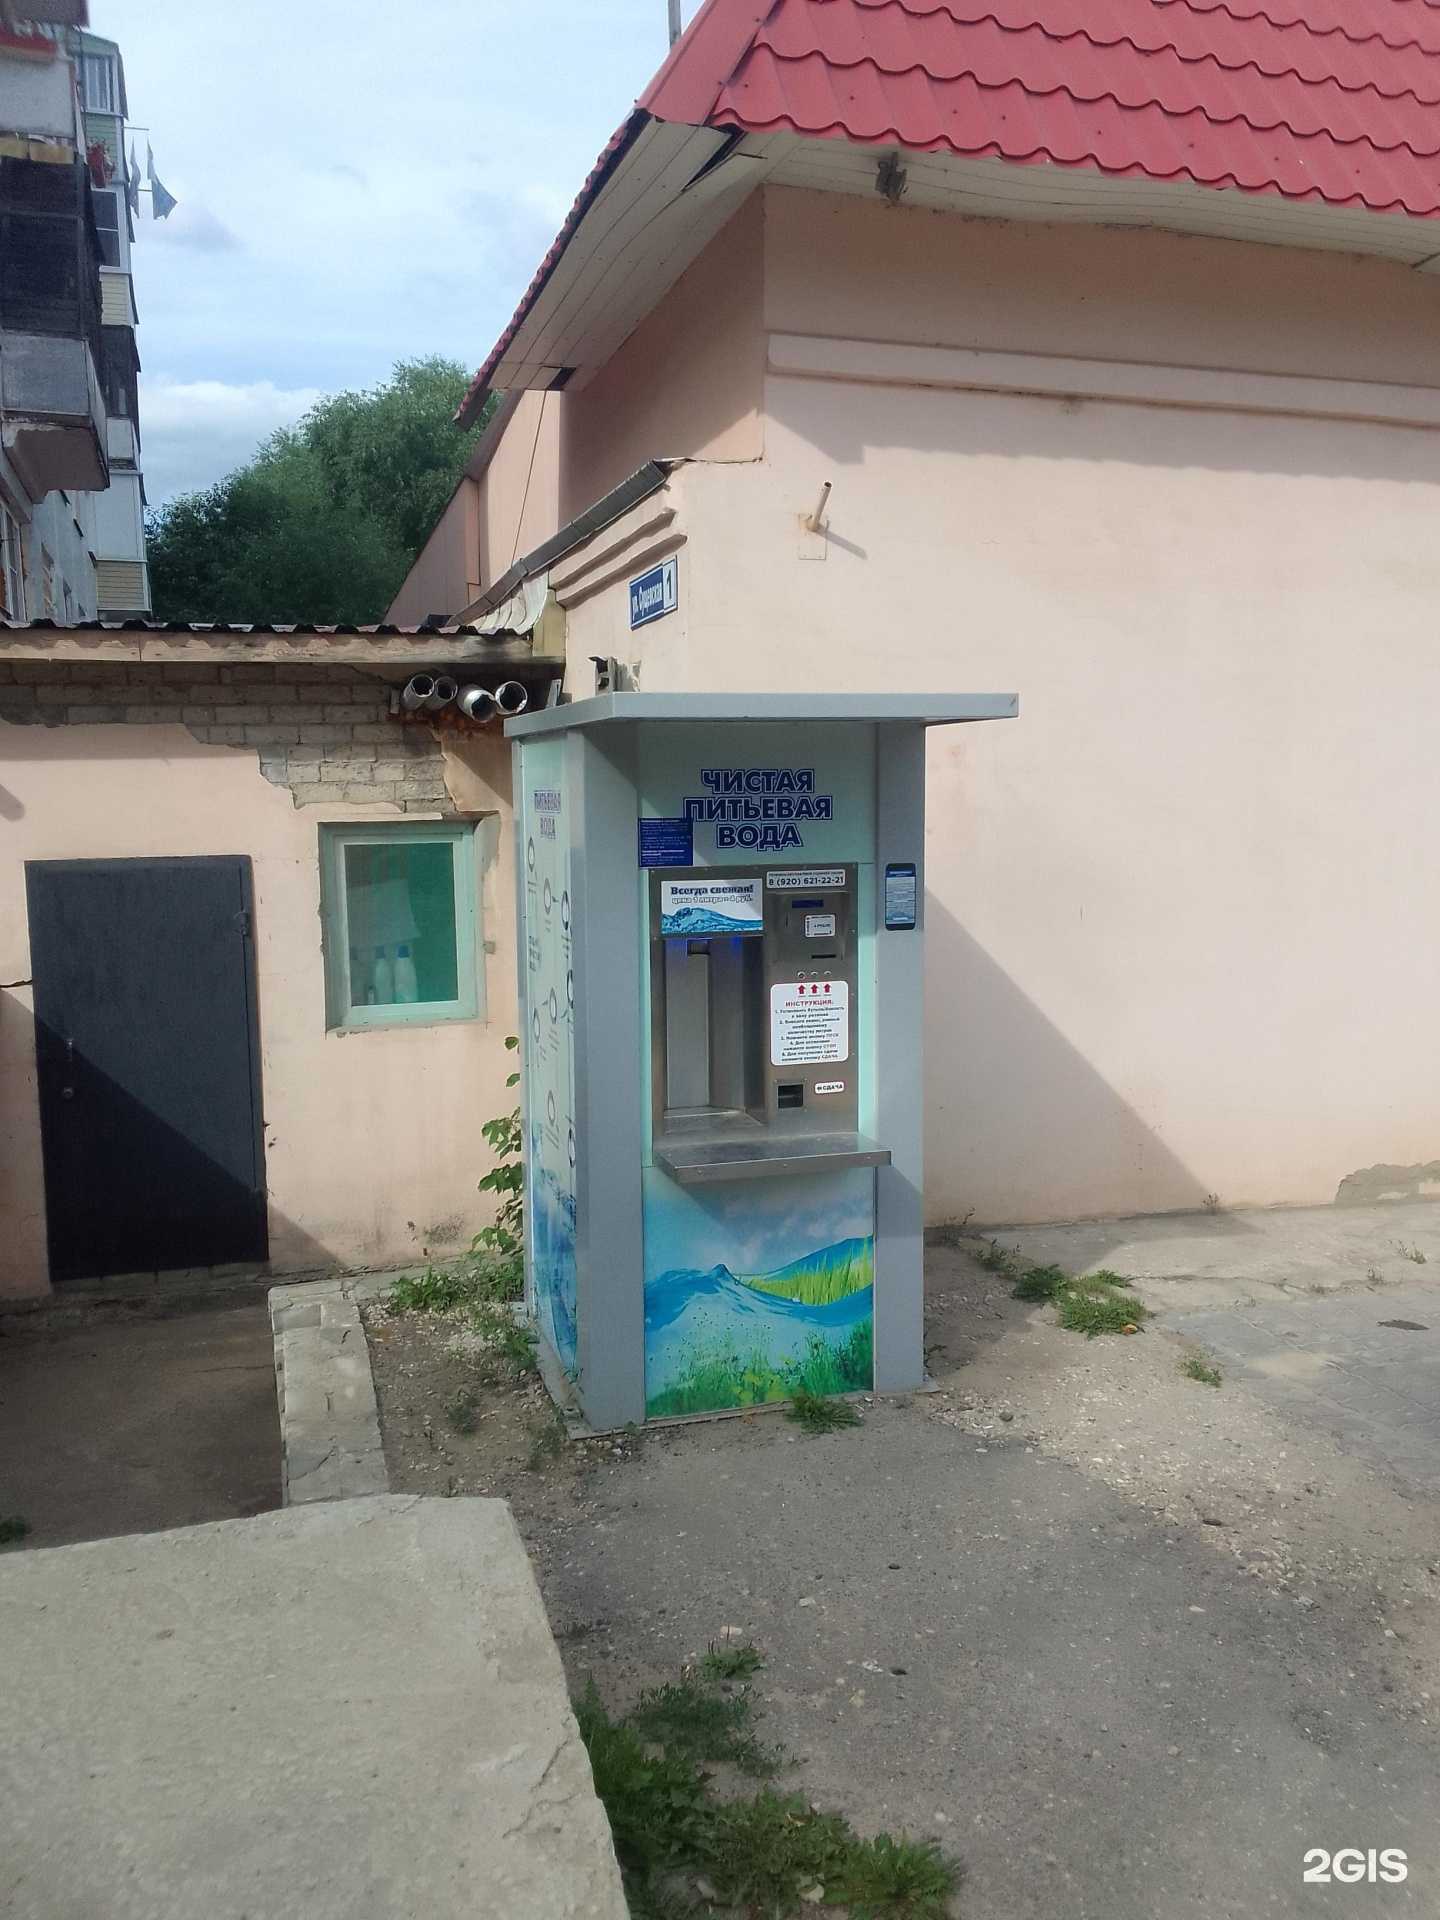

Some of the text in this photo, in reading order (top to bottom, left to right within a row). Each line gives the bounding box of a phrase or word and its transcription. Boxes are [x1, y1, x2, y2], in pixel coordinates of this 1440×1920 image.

[666, 569, 673, 600] 1
[701, 769, 815, 794] ЧИСТАЯ
[683, 796, 832, 821] ПИТЬЕВАЯ
[716, 823, 803, 851] ВОДА
[671, 884, 754, 896] Всегда свежая!
[769, 876, 844, 886] 8 (920) 621-22-21
